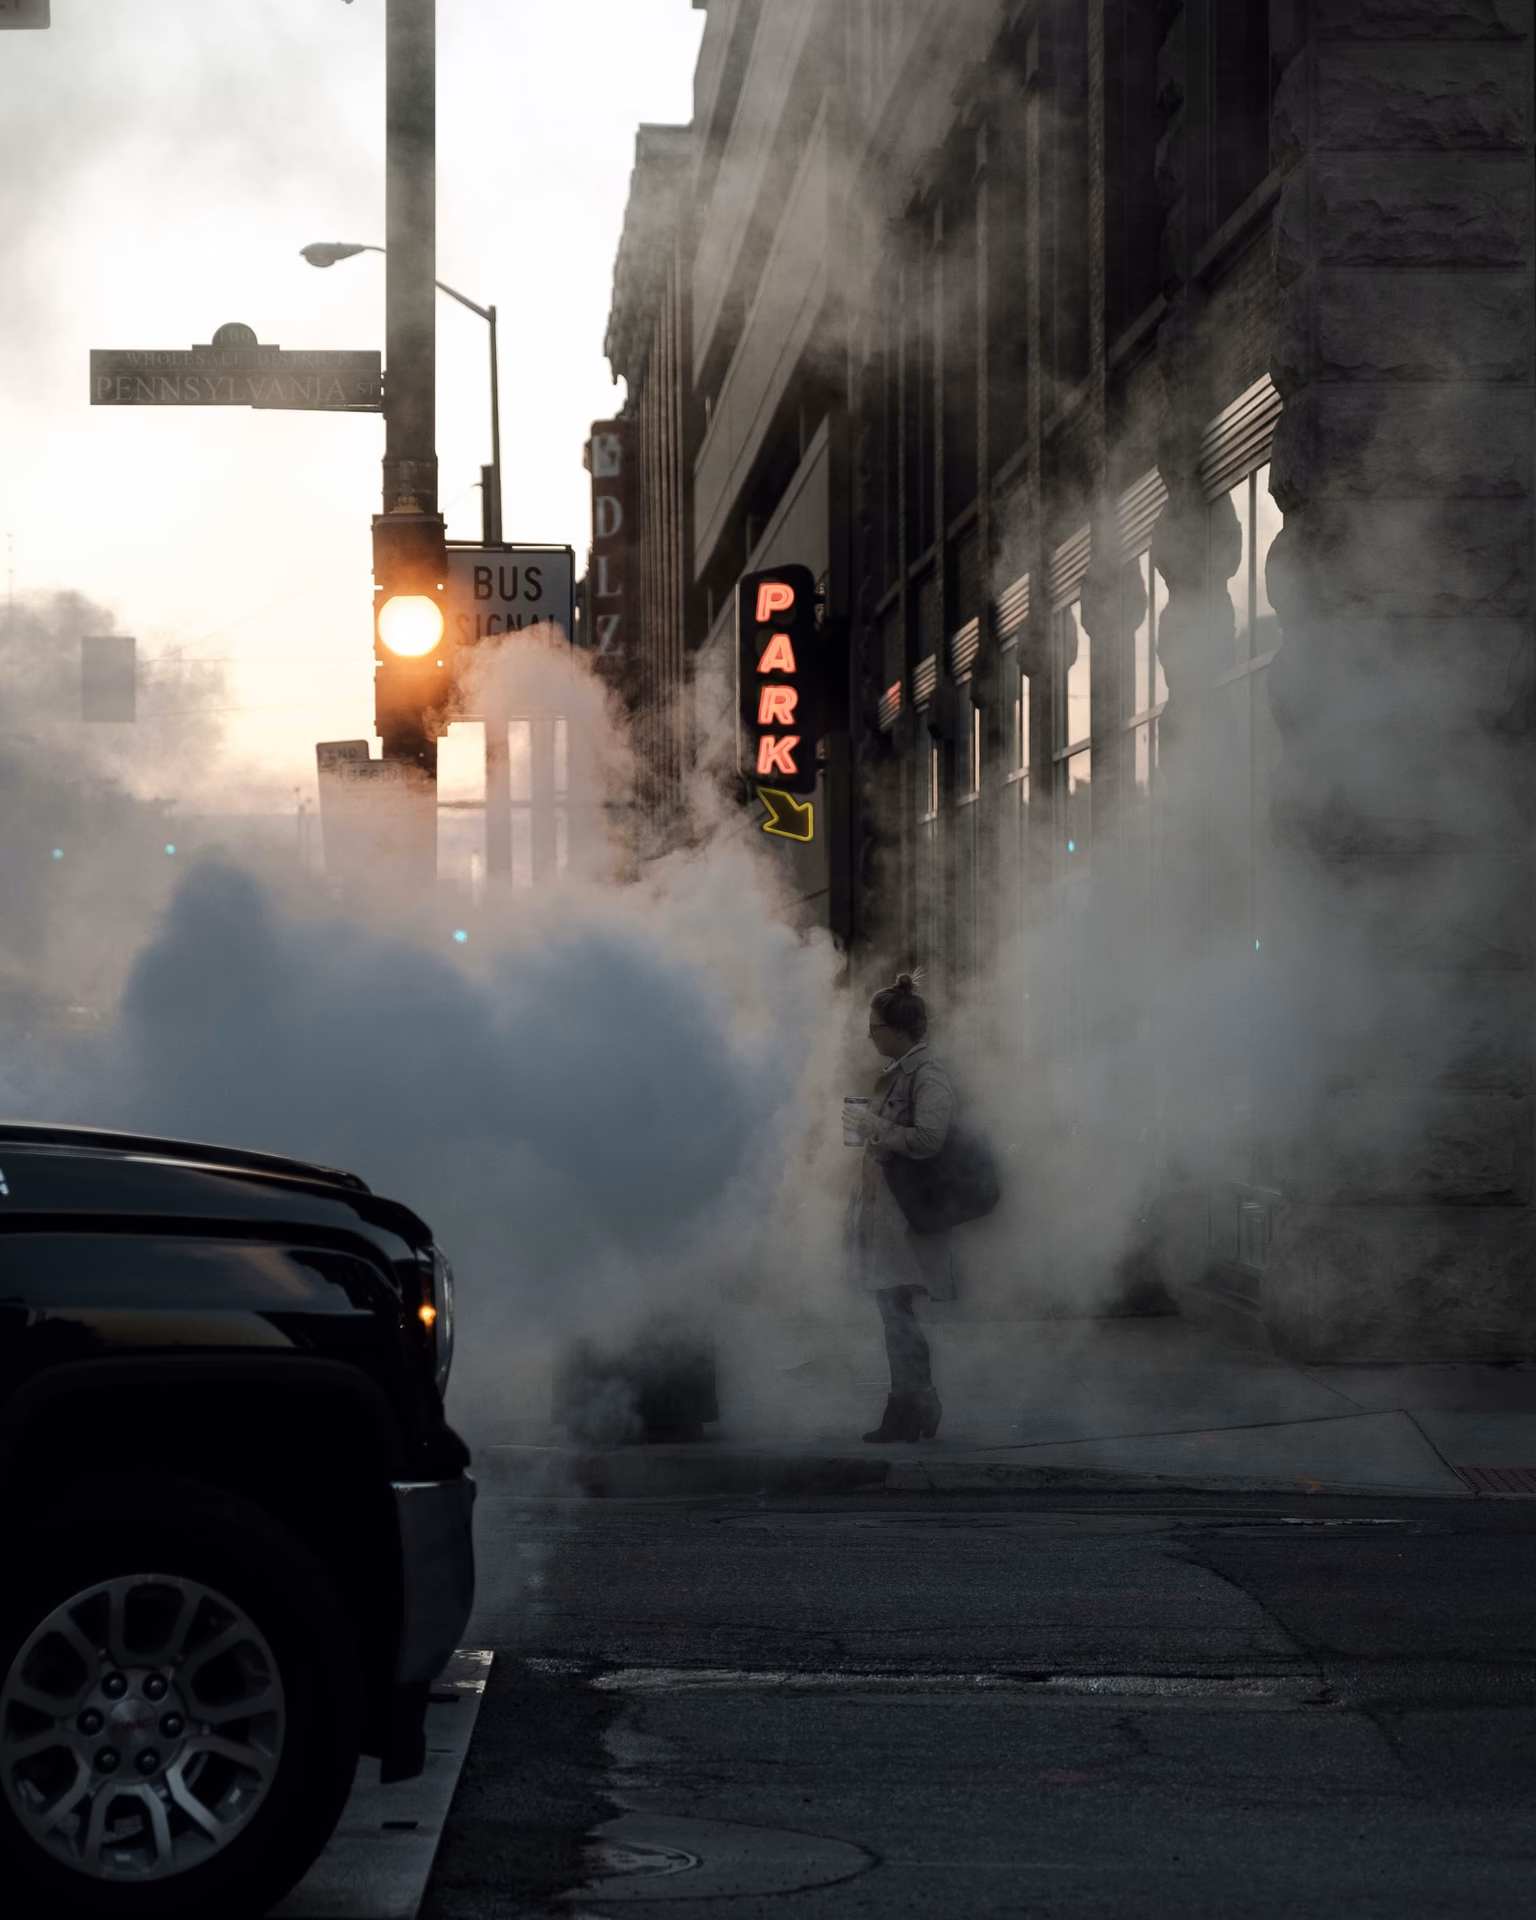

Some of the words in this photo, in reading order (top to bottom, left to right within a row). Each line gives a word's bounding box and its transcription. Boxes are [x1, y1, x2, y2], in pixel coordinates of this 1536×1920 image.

[95, 376, 347, 401] PENNSYLVANIA
[474, 565, 543, 601] BUS
[755, 582, 800, 775] PARK
